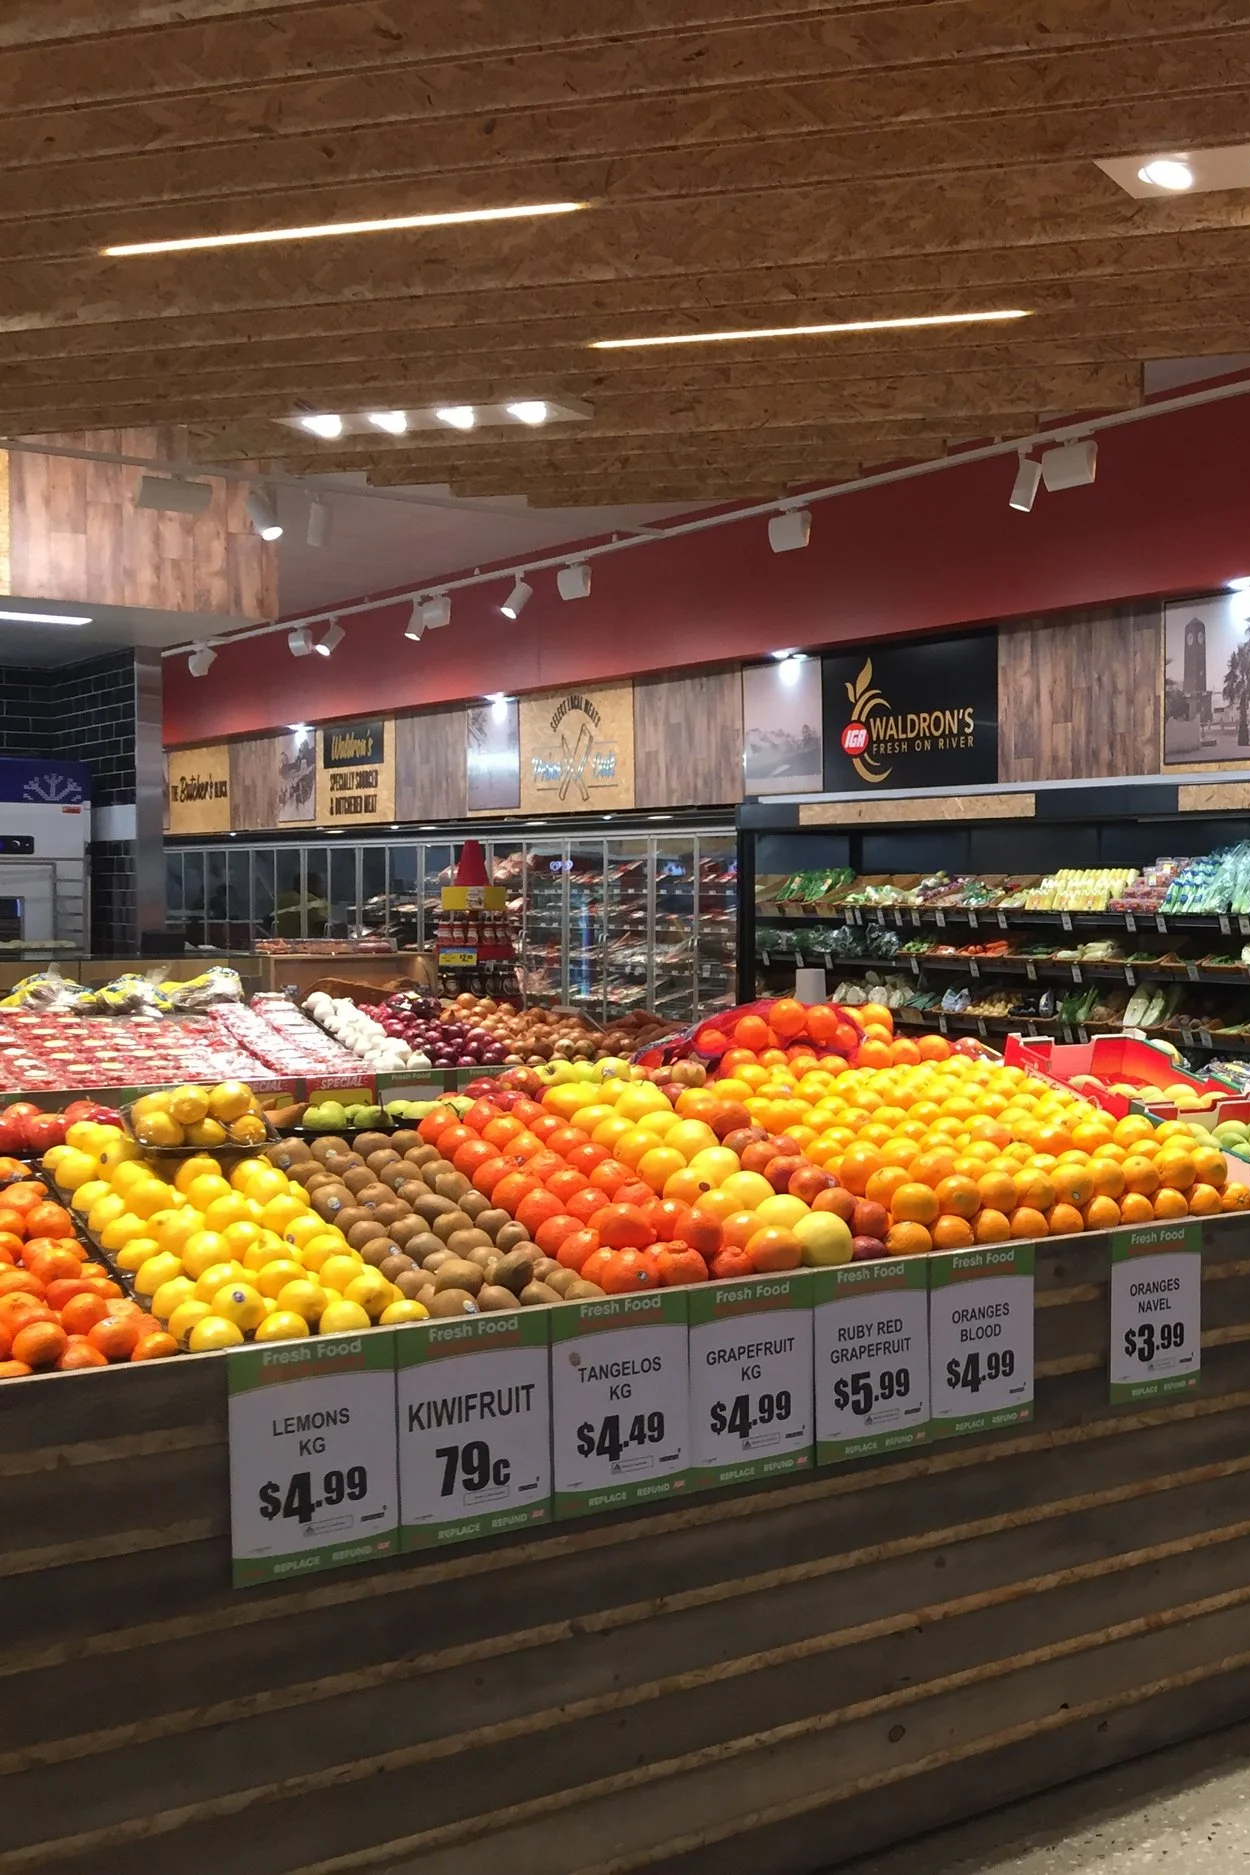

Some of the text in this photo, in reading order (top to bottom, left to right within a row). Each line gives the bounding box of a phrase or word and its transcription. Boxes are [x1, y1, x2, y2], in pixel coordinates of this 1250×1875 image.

[869, 707, 974, 742] WALDRON'S
[844, 729, 867, 748] IGA
[872, 736, 974, 755] FRESH ON RIVER
[180, 773, 213, 803] Butcher's
[320, 1077, 363, 1089] SPECIAL
[1131, 1228, 1185, 1245] Fresh Food
[952, 1250, 1015, 1269] Fresh Food
[837, 1263, 905, 1284] Fresh Food
[716, 1281, 790, 1304] Fresh Food
[1129, 1277, 1180, 1297] ORANGES
[580, 1295, 662, 1318] Fresh Food
[951, 1302, 1010, 1325] ORANGES
[1138, 1297, 1172, 1314] NAVEL
[429, 1317, 518, 1342] Fresh Food
[838, 1318, 903, 1342] RUBY RED
[960, 1323, 1002, 1343] BLOOD
[262, 1338, 362, 1366] Fresh Food
[706, 1337, 796, 1366] GRAPEFRUIT
[830, 1337, 911, 1365] GRAPEFRUIT
[1124, 1321, 1185, 1363] $3.99
[578, 1356, 662, 1383] TANGELOS
[741, 1364, 762, 1382] KG
[946, 1349, 1015, 1393] $4.99
[609, 1383, 632, 1401] KG
[833, 1367, 911, 1416] $5.99
[408, 1384, 535, 1433] KIWIFRUIT
[710, 1390, 792, 1439] $4.99
[272, 1408, 350, 1437] LEMONS
[299, 1437, 326, 1456] KG
[576, 1411, 665, 1462] $4.49
[435, 1440, 511, 1497] 79c
[258, 1465, 368, 1524] $4.99
